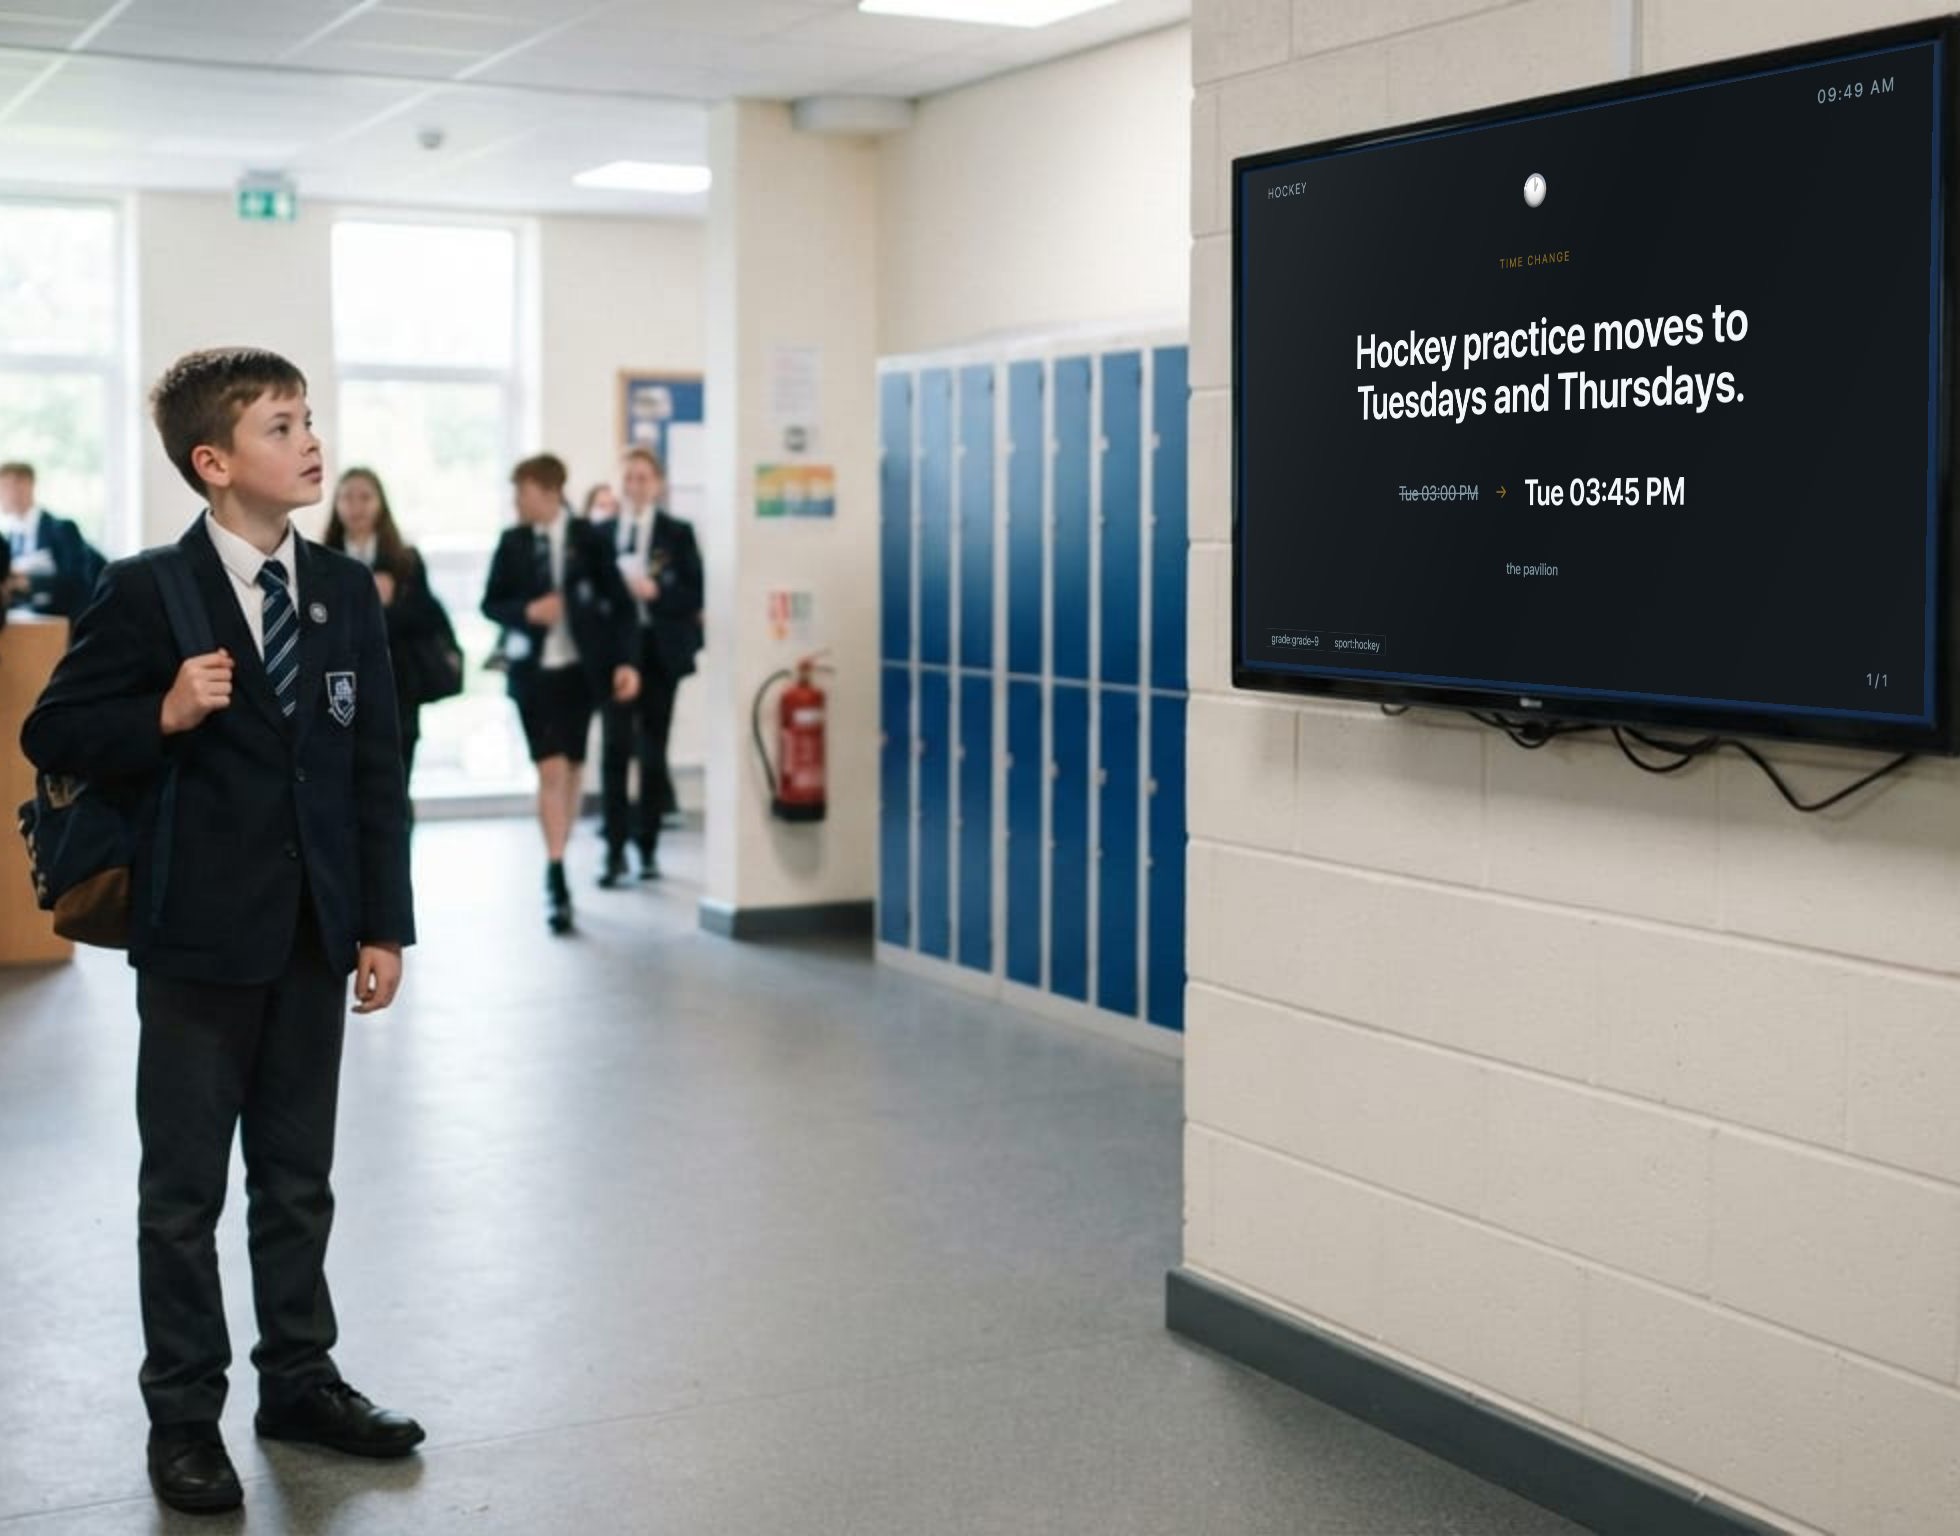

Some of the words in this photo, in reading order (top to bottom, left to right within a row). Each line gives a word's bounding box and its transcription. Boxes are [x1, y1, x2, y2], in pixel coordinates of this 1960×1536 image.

[1817, 82, 1864, 104] 09:49
[1870, 76, 1894, 96] AM
[1267, 182, 1307, 200] HOCKEY
[1499, 255, 1523, 269] TIME
[1527, 250, 1570, 266] CHANGE
[1356, 330, 1458, 372] Hockey
[1463, 316, 1586, 371] practice
[1593, 313, 1704, 352] moves
[1711, 304, 1749, 343] to
[1357, 380, 1487, 425] Tuesdays
[1493, 373, 1550, 415] and
[1557, 364, 1745, 415] Thursdays.
[1399, 485, 1418, 502] Tue
[1421, 485, 1455, 502] 03:00
[1459, 484, 1478, 502] PM
[1524, 478, 1564, 507] Tue
[1569, 477, 1640, 507] 03:45
[1646, 476, 1685, 506] PM
[1505, 562, 1522, 575] the
[1523, 562, 1559, 579] pavilion
[1271, 634, 1319, 647] grade:grade-9
[1334, 638, 1380, 653] sport:hockey
